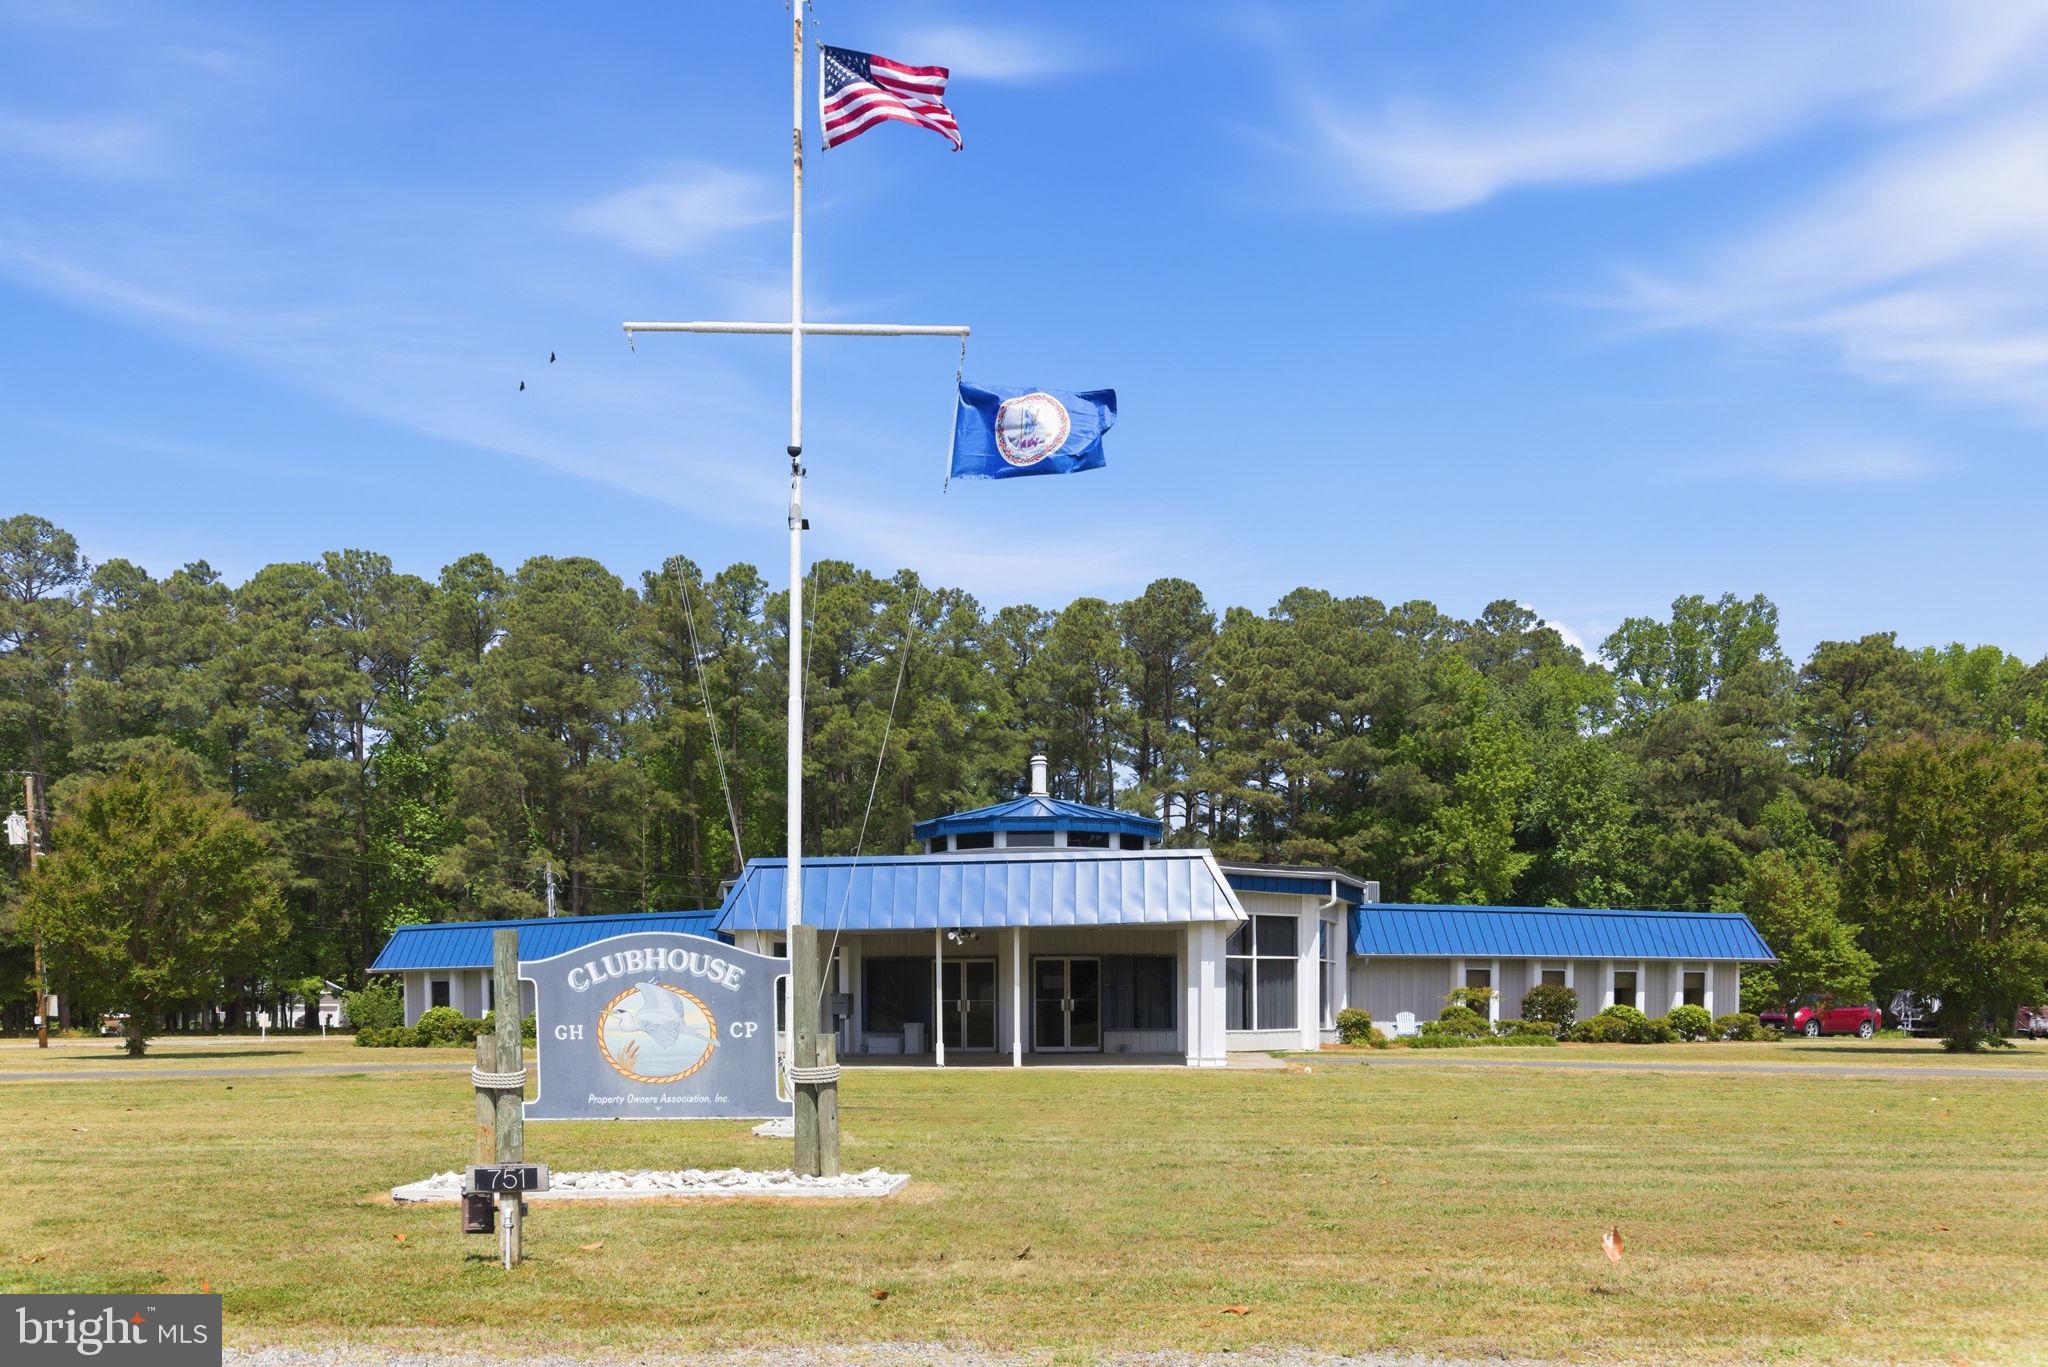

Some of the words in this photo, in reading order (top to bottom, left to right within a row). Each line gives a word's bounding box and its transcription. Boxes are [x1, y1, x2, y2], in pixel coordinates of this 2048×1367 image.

[567, 947, 745, 992] CLUBHOUSE
[554, 1024, 583, 1040] GH
[729, 1022, 757, 1038] CP
[588, 1093, 625, 1105] Property
[627, 1093, 658, 1104] Owners
[715, 1093, 730, 1103] Inc.
[487, 1168, 526, 1189] 751
